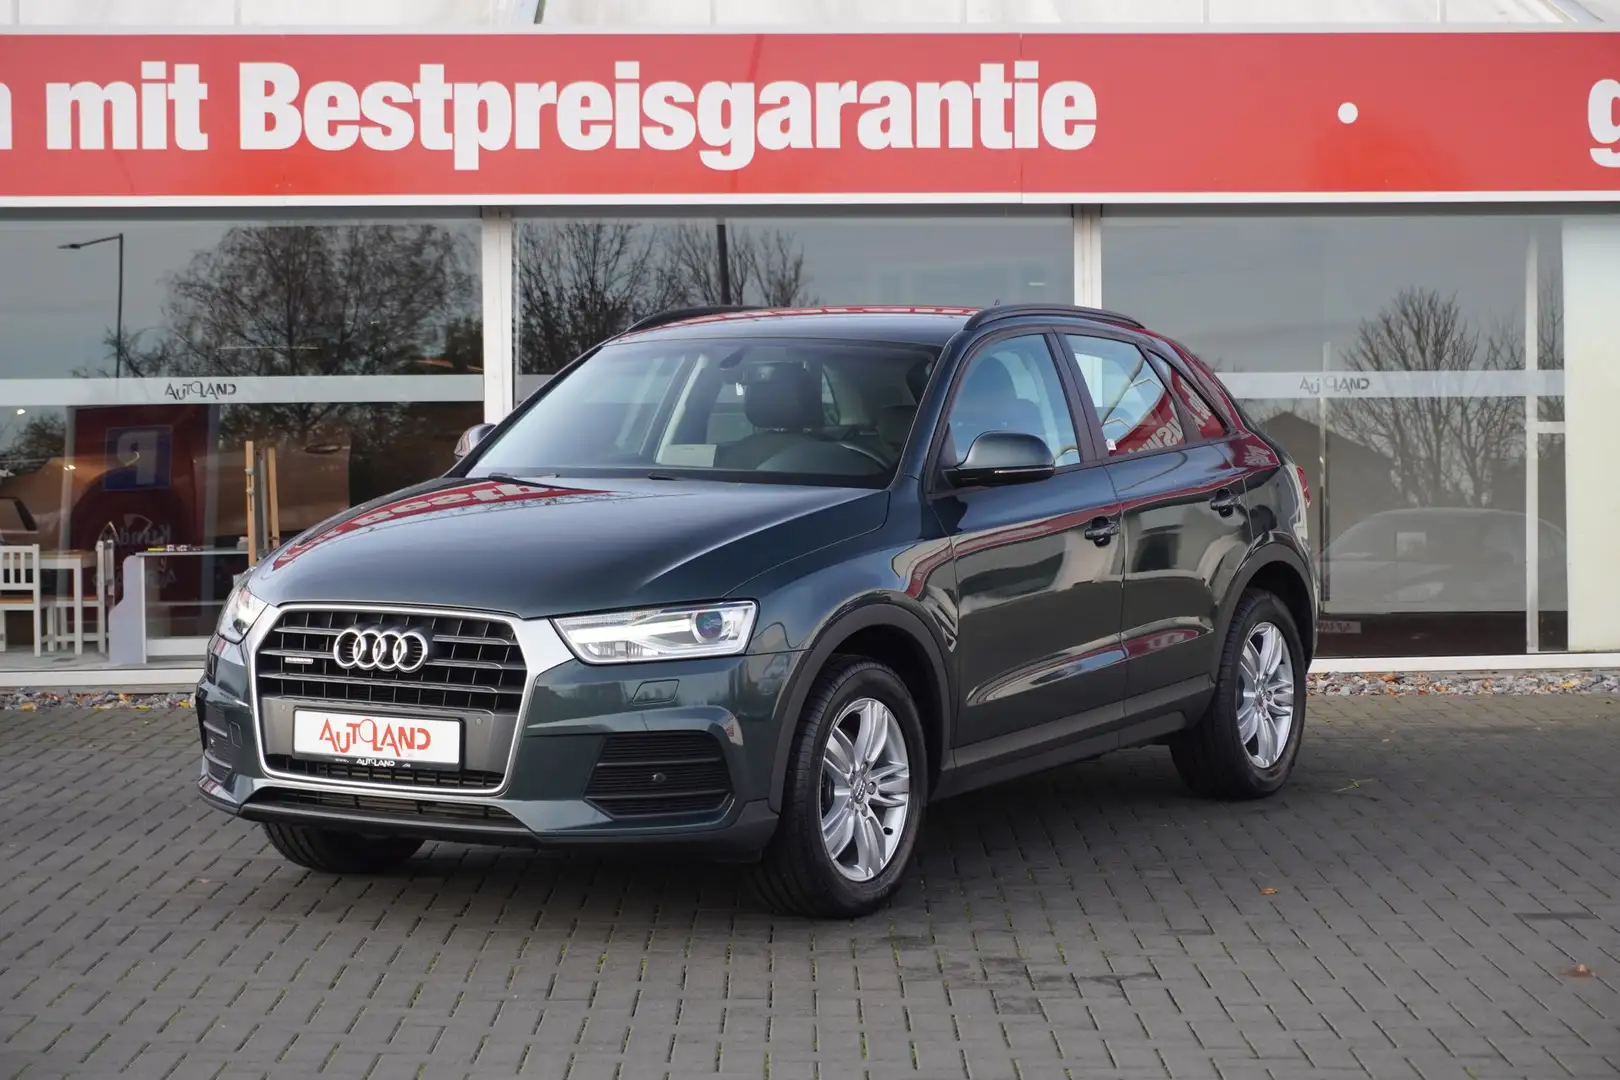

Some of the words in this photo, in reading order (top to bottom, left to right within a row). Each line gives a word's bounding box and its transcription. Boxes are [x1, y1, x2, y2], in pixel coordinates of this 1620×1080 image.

[46, 61, 208, 150] mit
[239, 61, 1097, 171] Bestpreisgarantie
[319, 718, 431, 757] AUTOLAND
